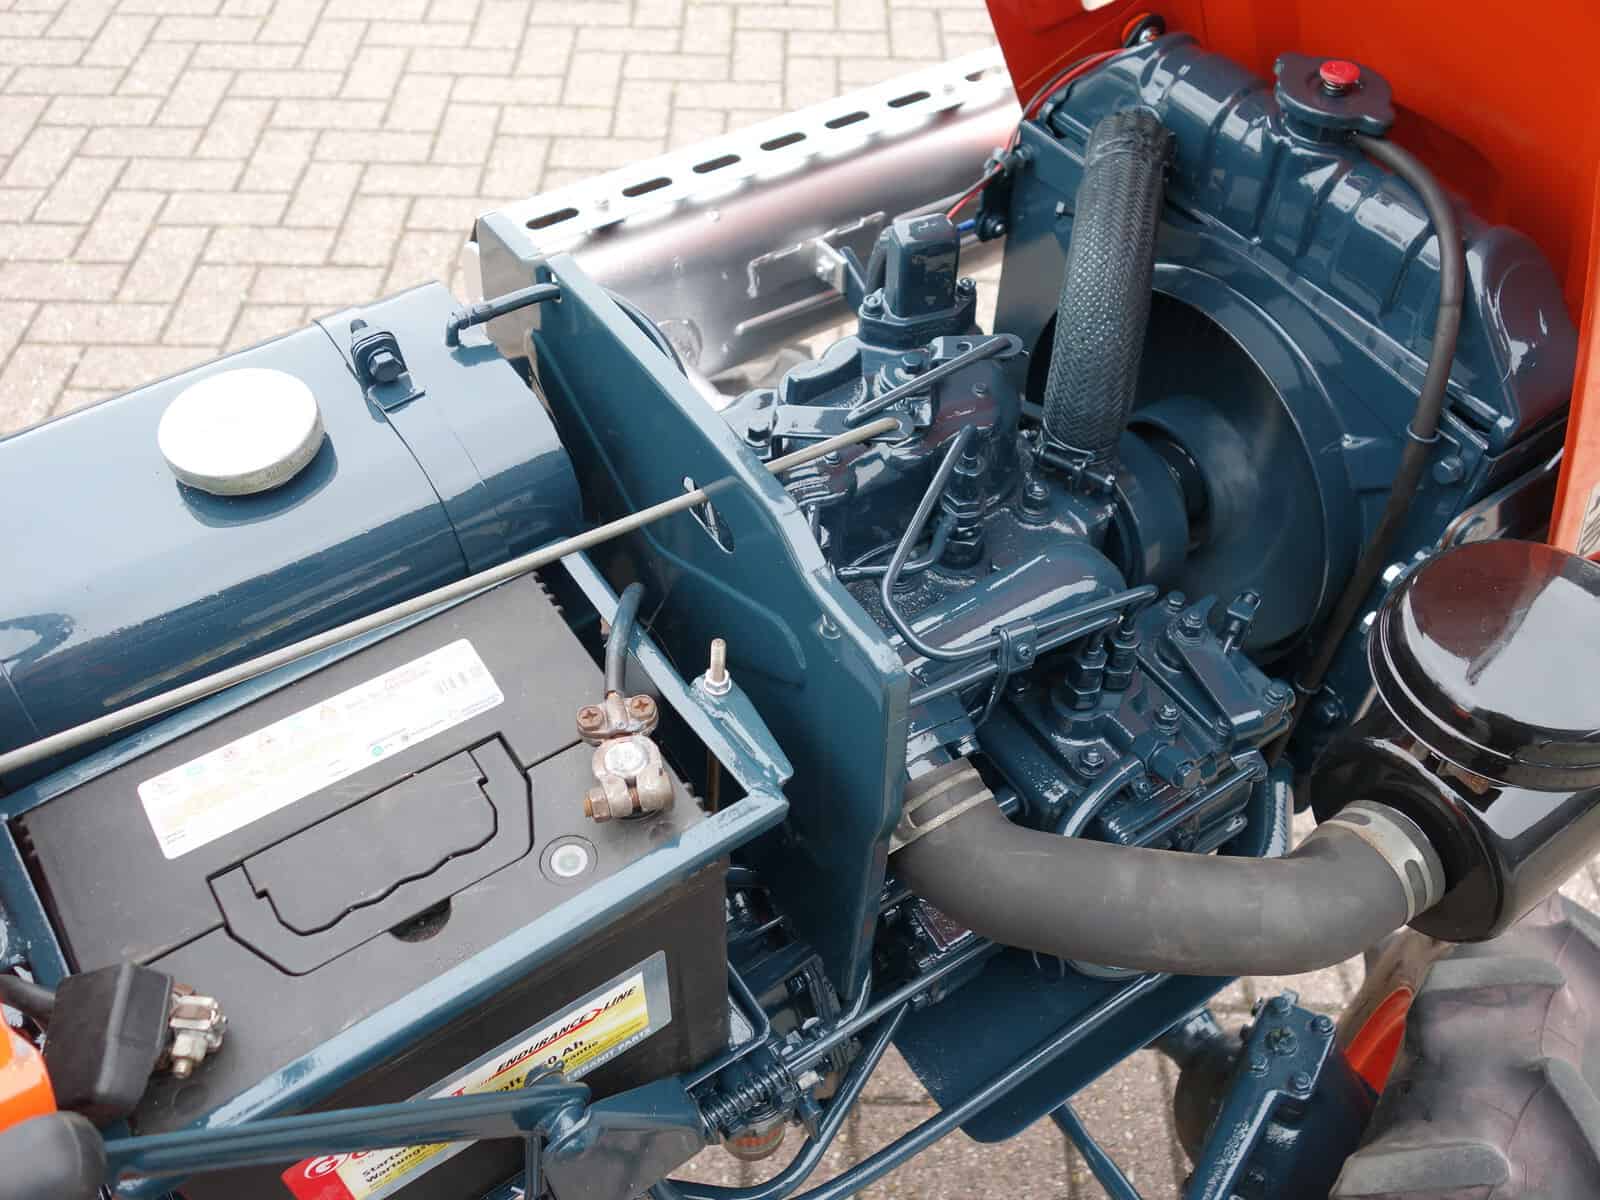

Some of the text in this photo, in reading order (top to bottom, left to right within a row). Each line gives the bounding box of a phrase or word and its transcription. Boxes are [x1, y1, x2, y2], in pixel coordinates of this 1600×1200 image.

[496, 1013, 588, 1073] ENDURANCE
[603, 985, 637, 1012] LINE
[562, 1040, 584, 1057] Ah
